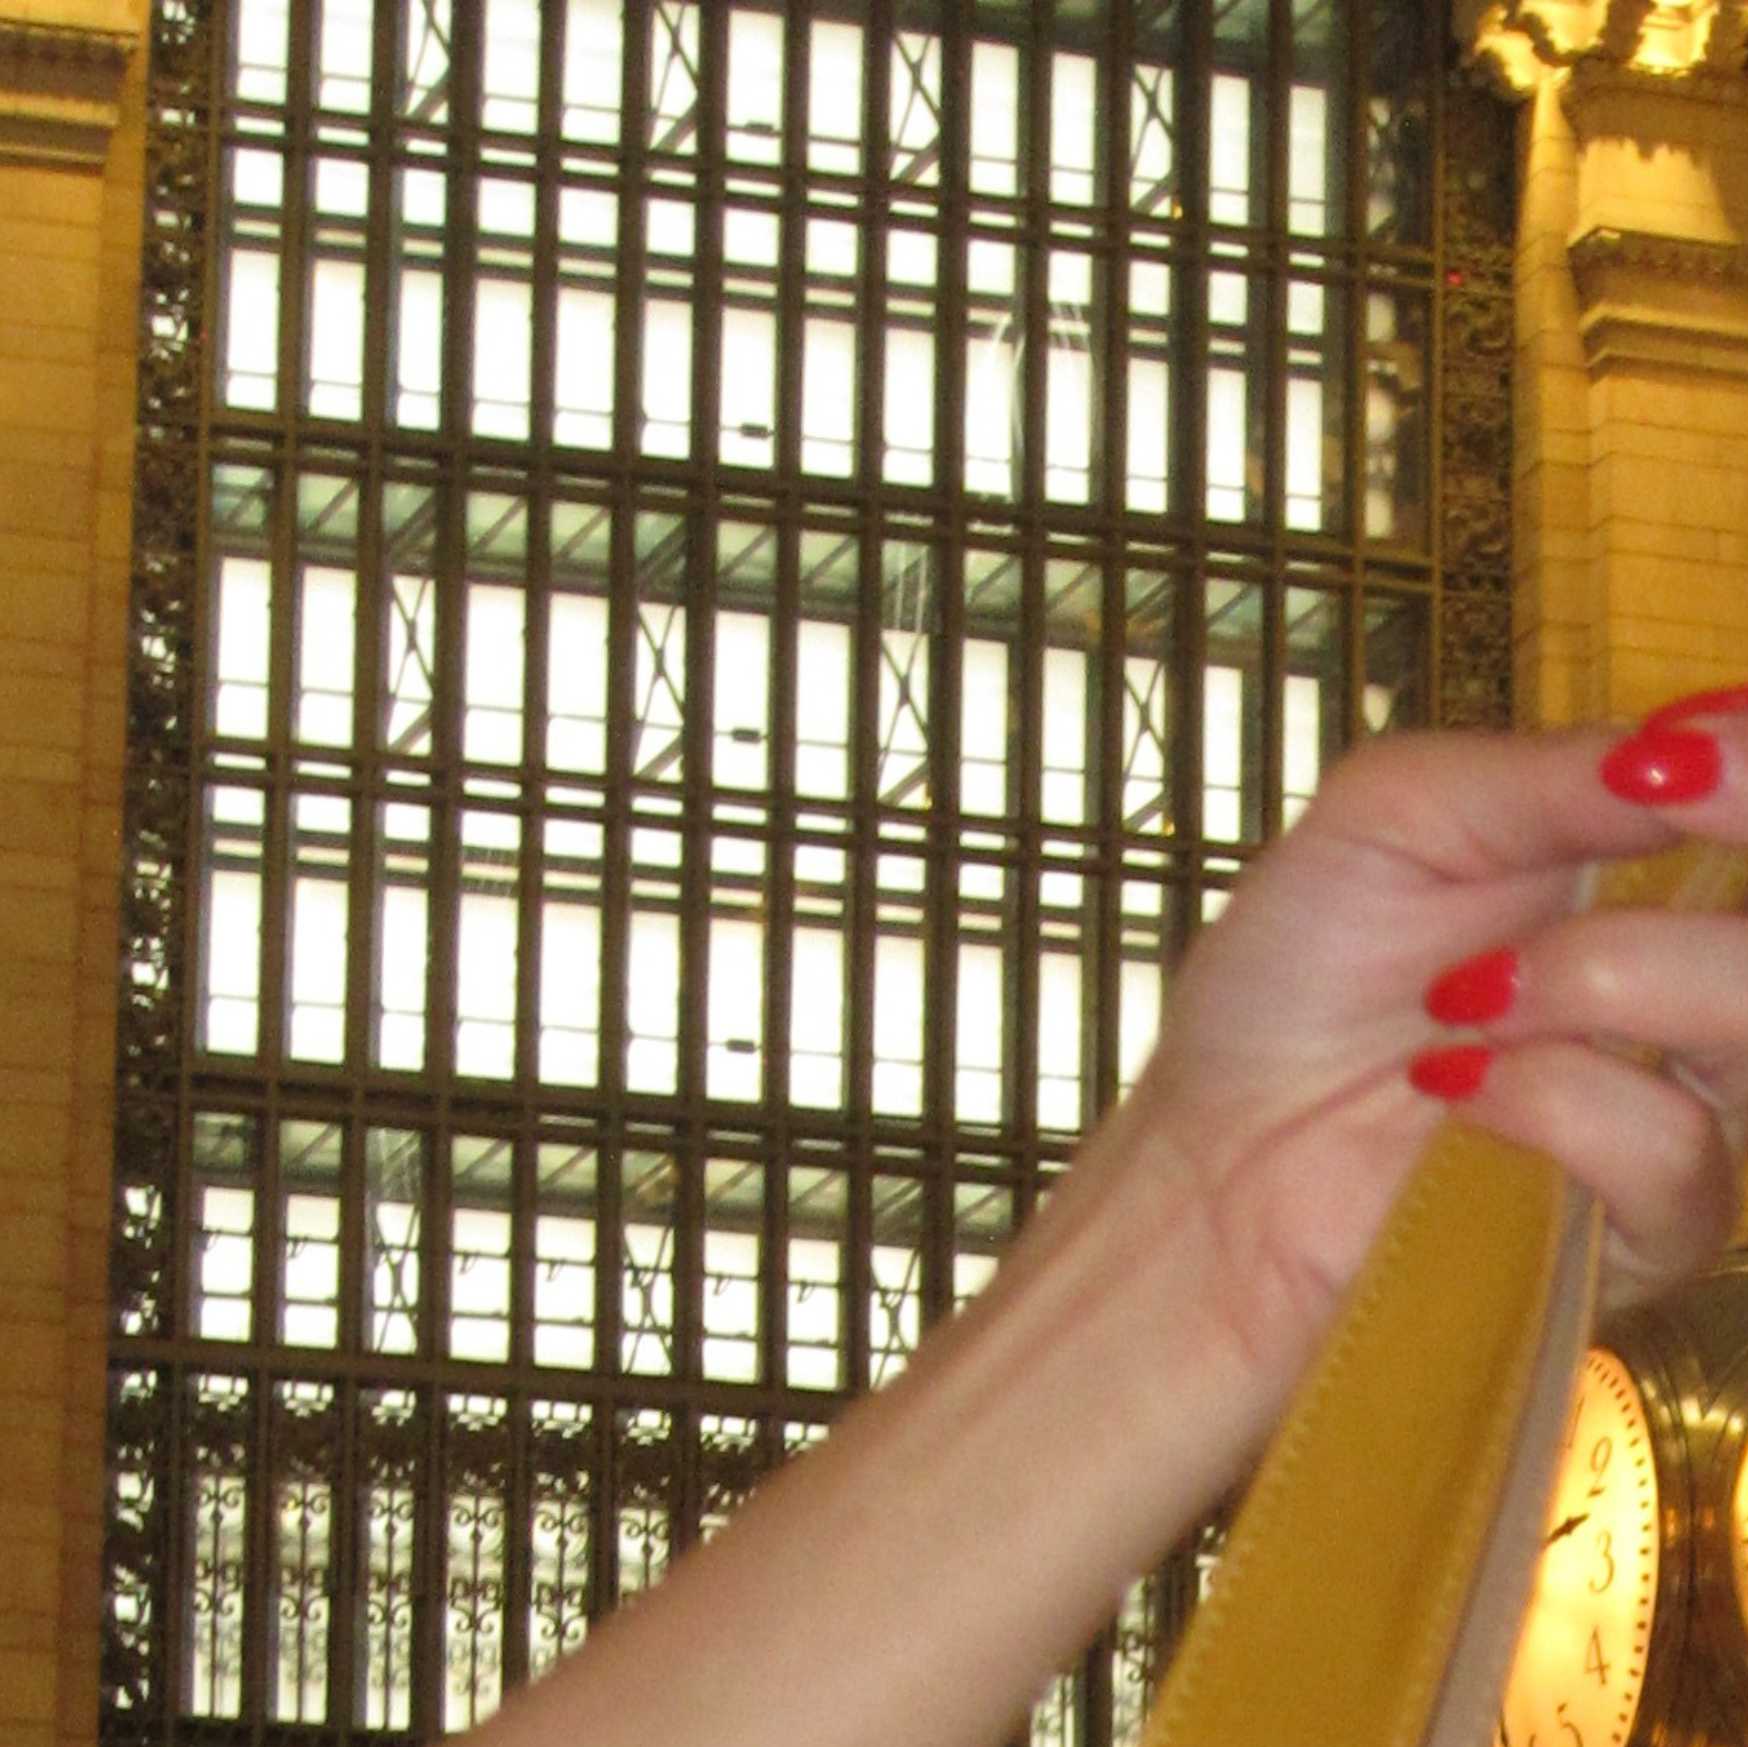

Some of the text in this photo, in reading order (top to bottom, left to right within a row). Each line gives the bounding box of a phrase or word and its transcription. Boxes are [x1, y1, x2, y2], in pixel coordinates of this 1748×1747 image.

[1586, 1436, 1613, 1498] 2
[1588, 1529, 1614, 1593] 3
[1584, 1624, 1611, 1686] 4
